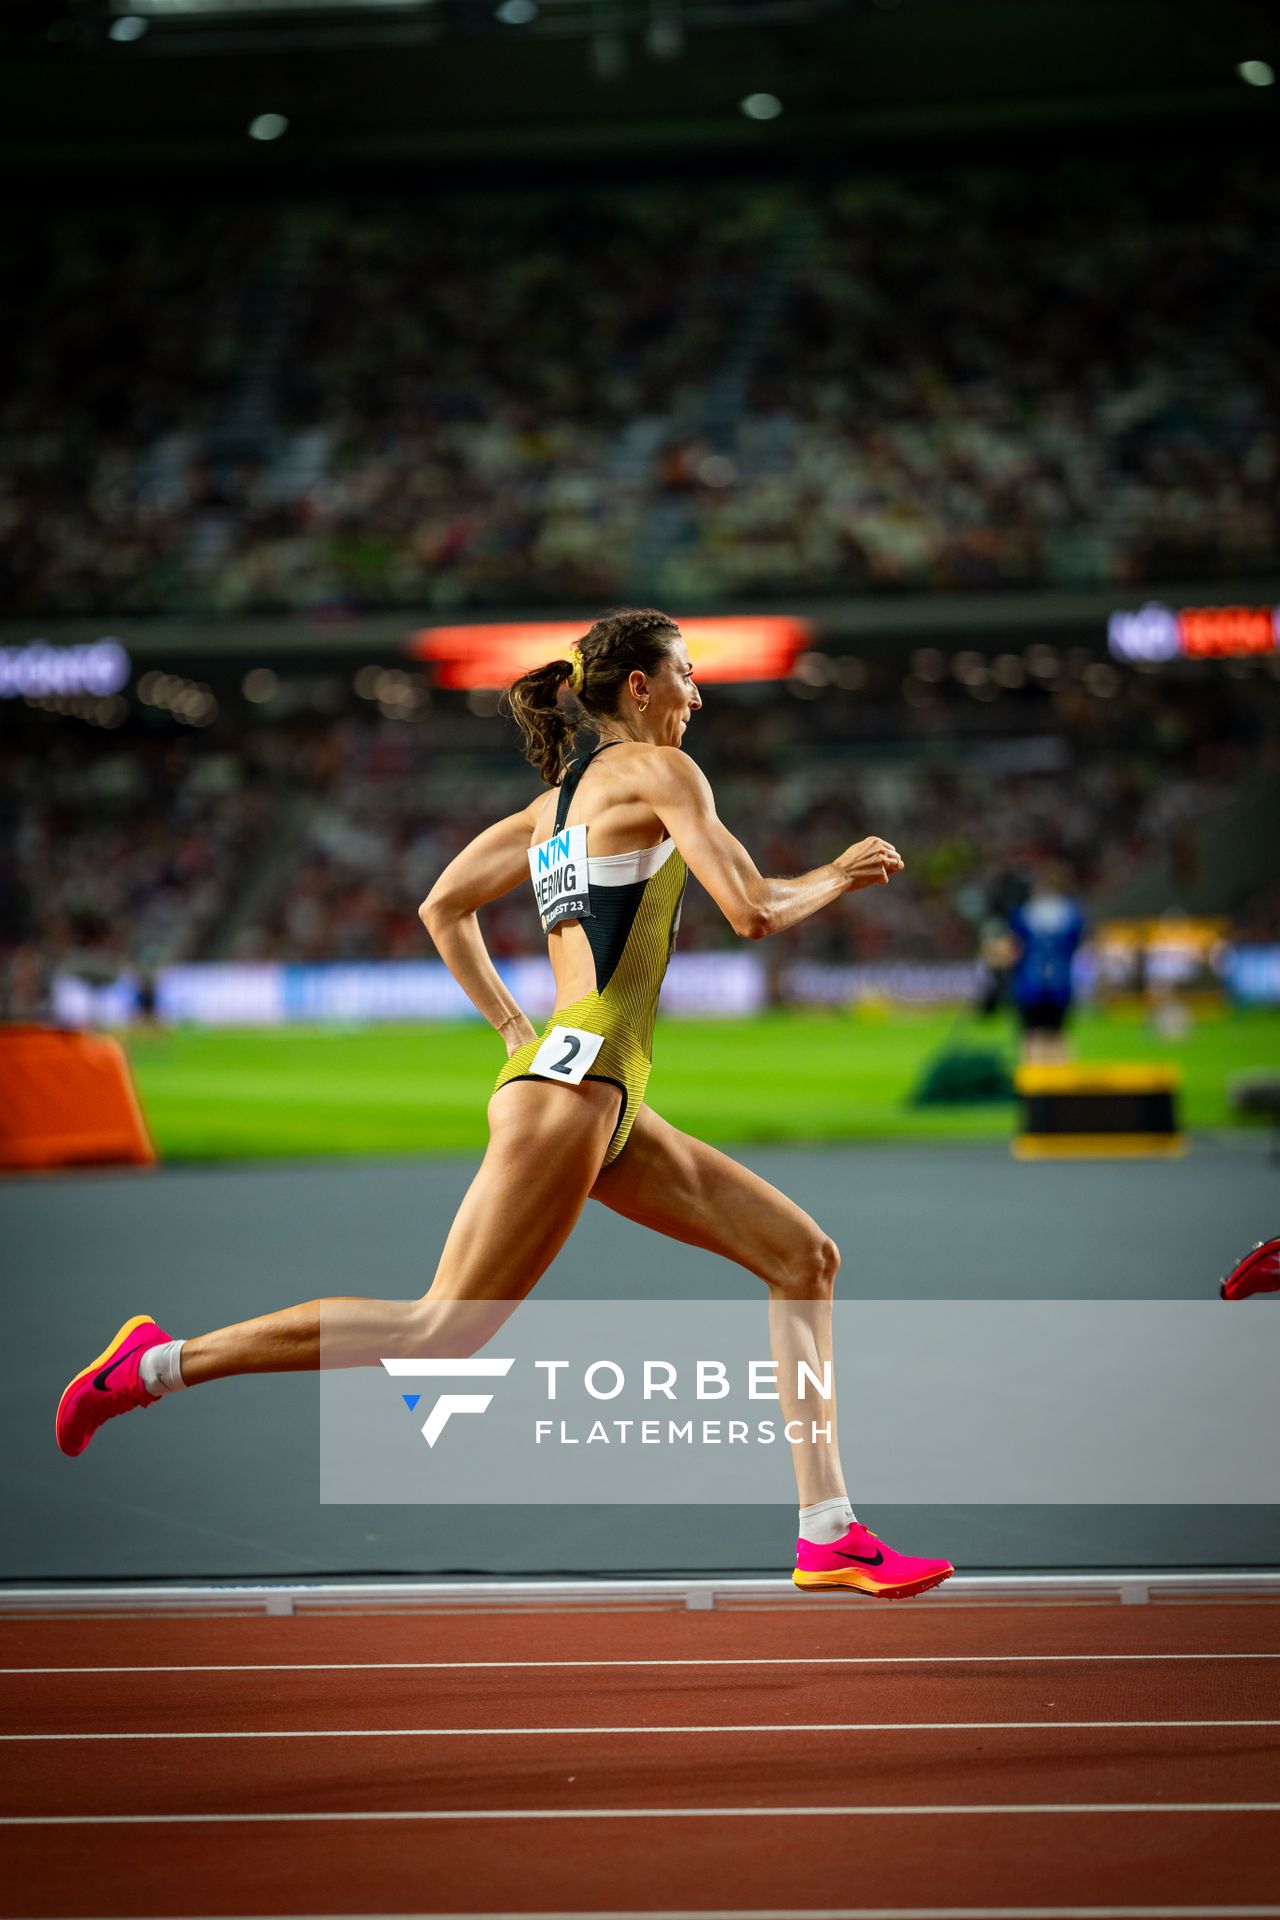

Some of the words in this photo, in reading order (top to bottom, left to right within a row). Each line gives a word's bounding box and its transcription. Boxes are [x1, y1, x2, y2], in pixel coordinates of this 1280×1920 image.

[538, 830, 570, 873] NTN
[535, 863, 577, 909] HERING
[570, 900, 584, 912] 23
[550, 1035, 581, 1075] 2
